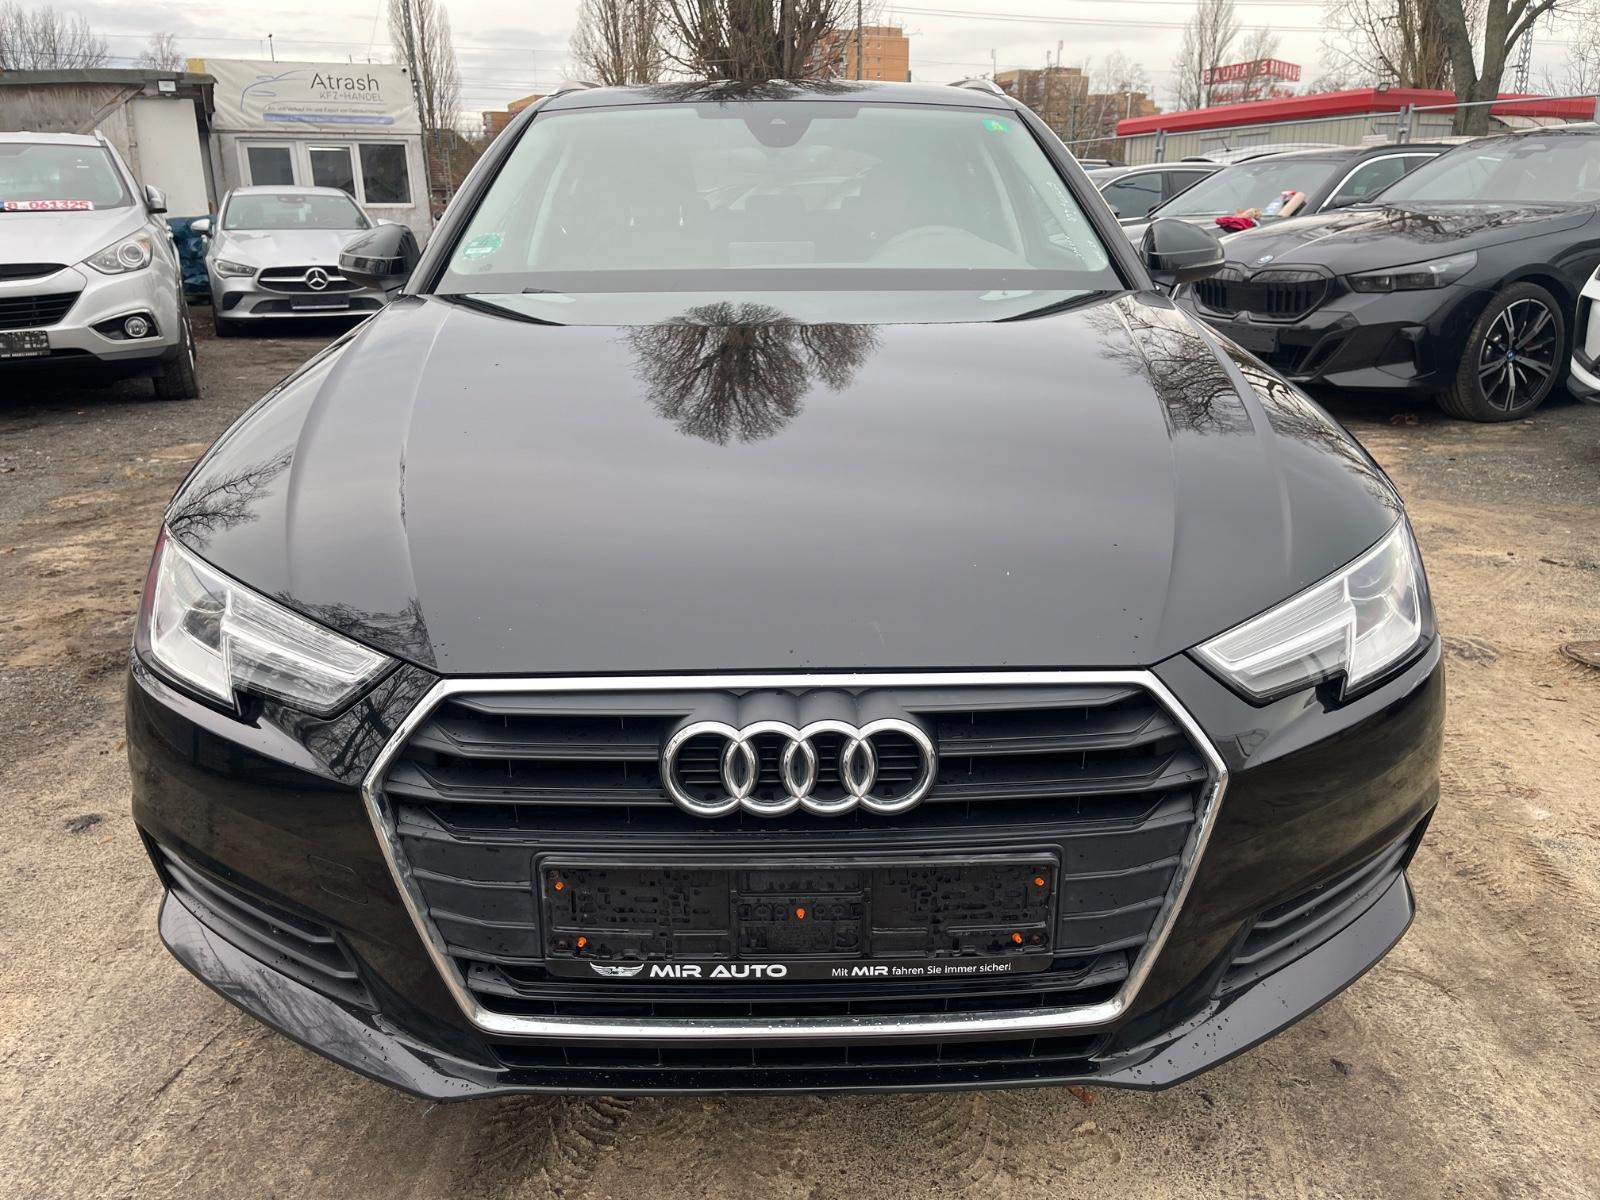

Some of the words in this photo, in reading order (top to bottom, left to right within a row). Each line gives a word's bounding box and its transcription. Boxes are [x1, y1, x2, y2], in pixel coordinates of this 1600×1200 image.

[310, 72, 379, 91] Atrash
[319, 91, 384, 102] KFZ-HANDEL
[650, 964, 702, 978] MIR
[709, 964, 788, 978] AUTO
[831, 968, 848, 977] Mit
[851, 966, 889, 976] MIR
[892, 966, 924, 975] fahren
[927, 965, 942, 974] Sie
[944, 964, 976, 973] immer
[979, 962, 1012, 972] sicher!
